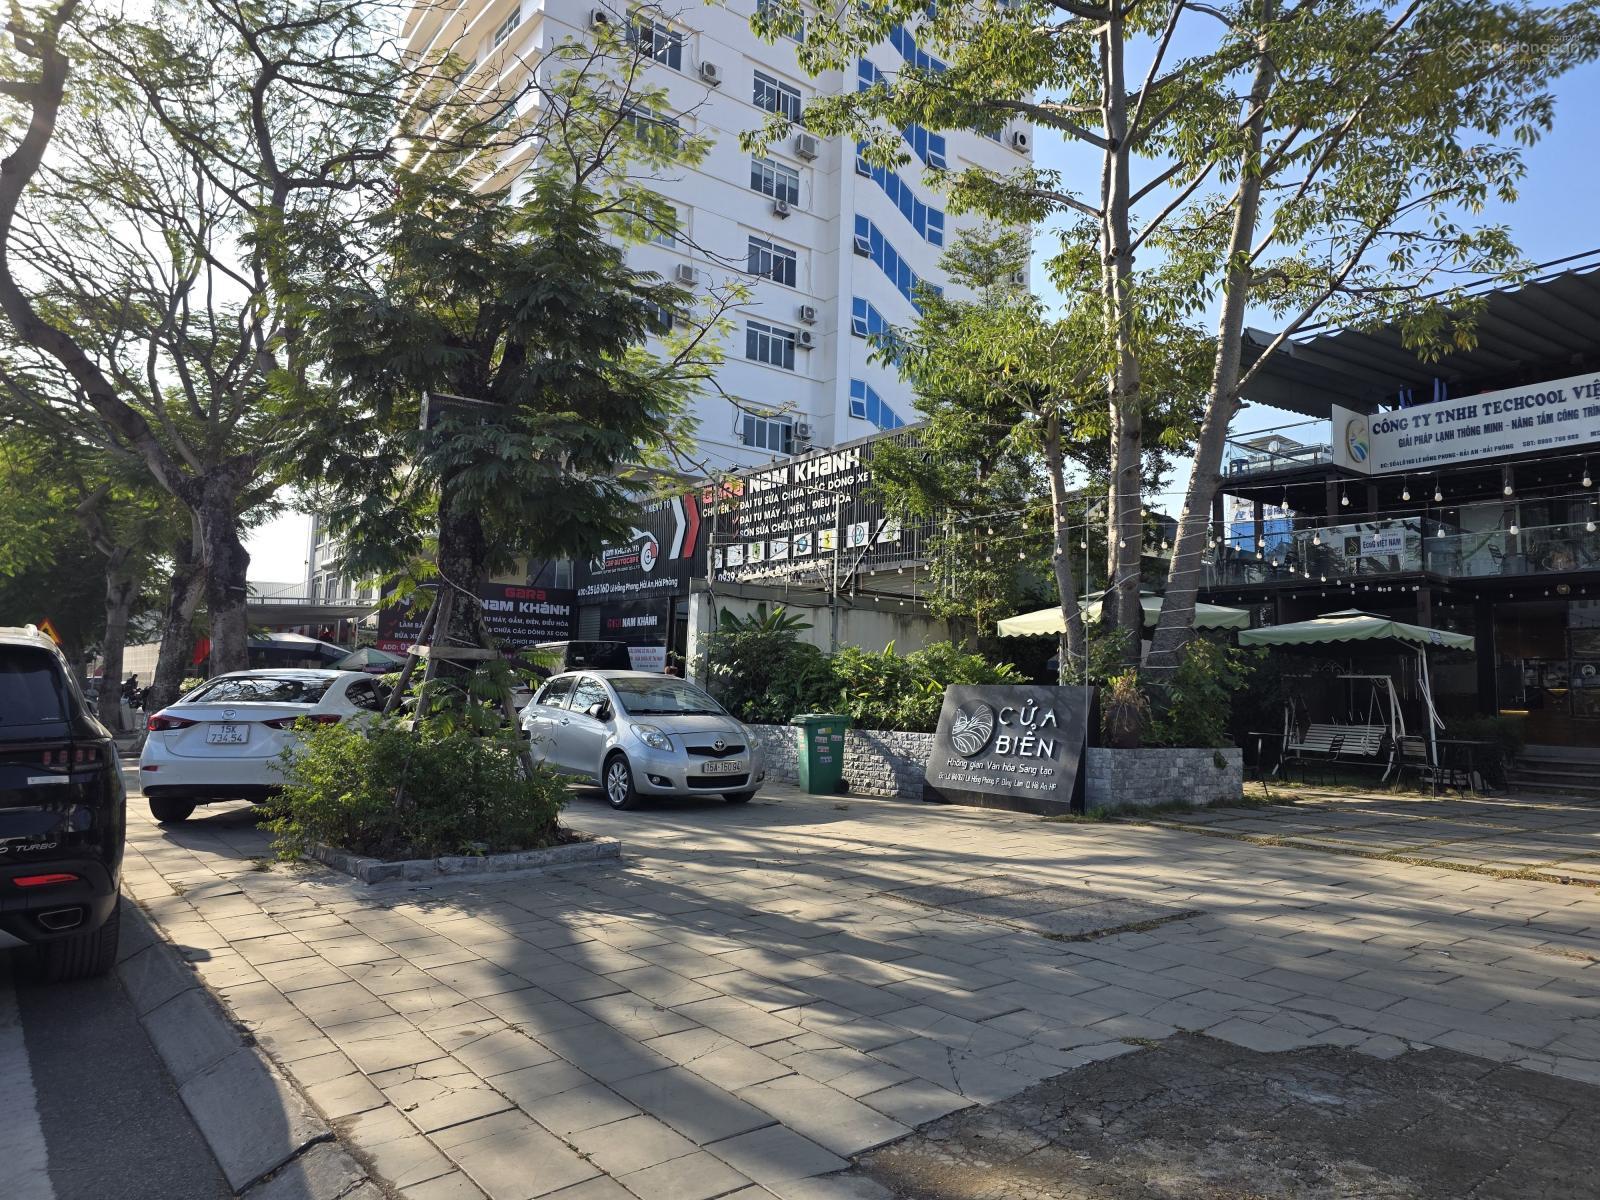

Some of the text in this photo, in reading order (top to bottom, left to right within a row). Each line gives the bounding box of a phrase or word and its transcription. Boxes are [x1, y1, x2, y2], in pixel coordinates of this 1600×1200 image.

[1372, 417, 1409, 435] CÔNG
[1412, 413, 1431, 428] TY
[1435, 404, 1478, 425] TNHH
[1482, 389, 1567, 417] TECHCOOL
[1398, 433, 1412, 448] GIẢI
[1414, 431, 1433, 446] PHÁP
[1435, 429, 1455, 443] LẠNH
[1484, 422, 1503, 434] MINH
[1557, 408, 1579, 422] CÔNG
[754, 498, 762, 508] TU
[827, 475, 855, 490] DÒNG
[857, 472, 869, 483] XE
[754, 513, 762, 521] TU
[763, 506, 781, 520] MÁY
[1388, 537, 1402, 547] NAM
[622, 617, 636, 628] NAM
[636, 613, 658, 627] KHÁNH
[527, 628, 545, 636] DÒNG
[998, 698, 1058, 728] CỬA
[994, 723, 1054, 759] BIỂN
[969, 761, 984, 771] gian
[1002, 762, 1017, 773] hóa
[15, 842, 57, 852] TURBO
